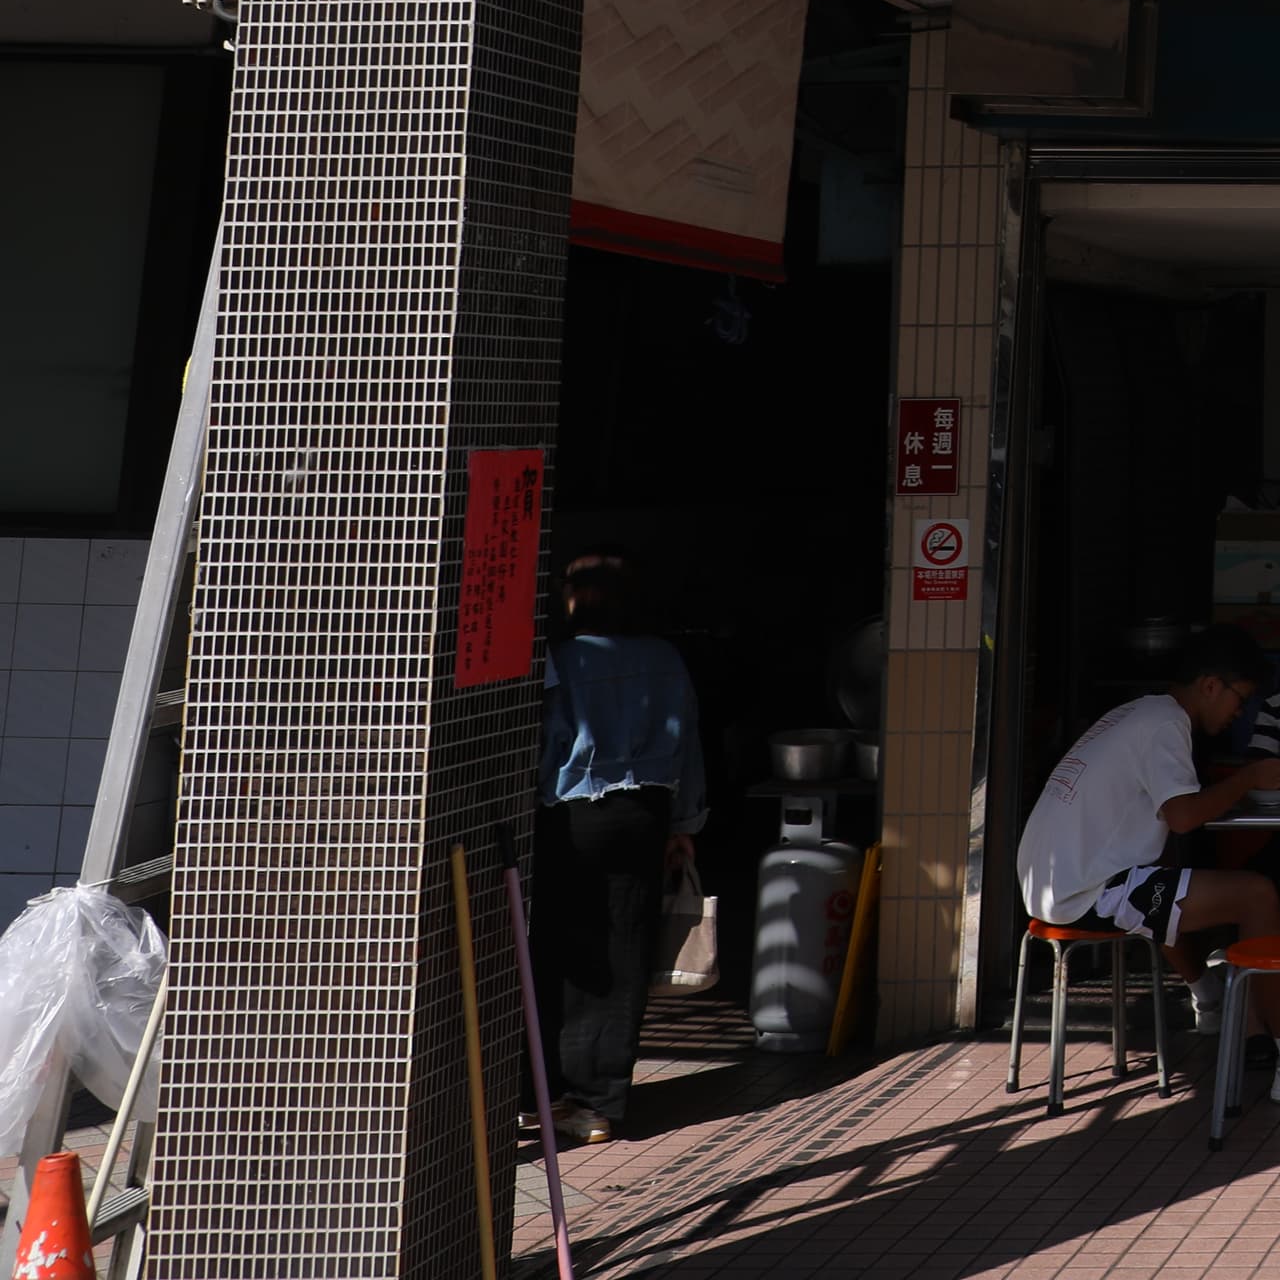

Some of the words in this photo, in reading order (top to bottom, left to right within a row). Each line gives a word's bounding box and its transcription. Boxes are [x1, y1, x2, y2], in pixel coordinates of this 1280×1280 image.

[902, 431, 925, 487] 休息
[931, 407, 955, 470] 每週一
